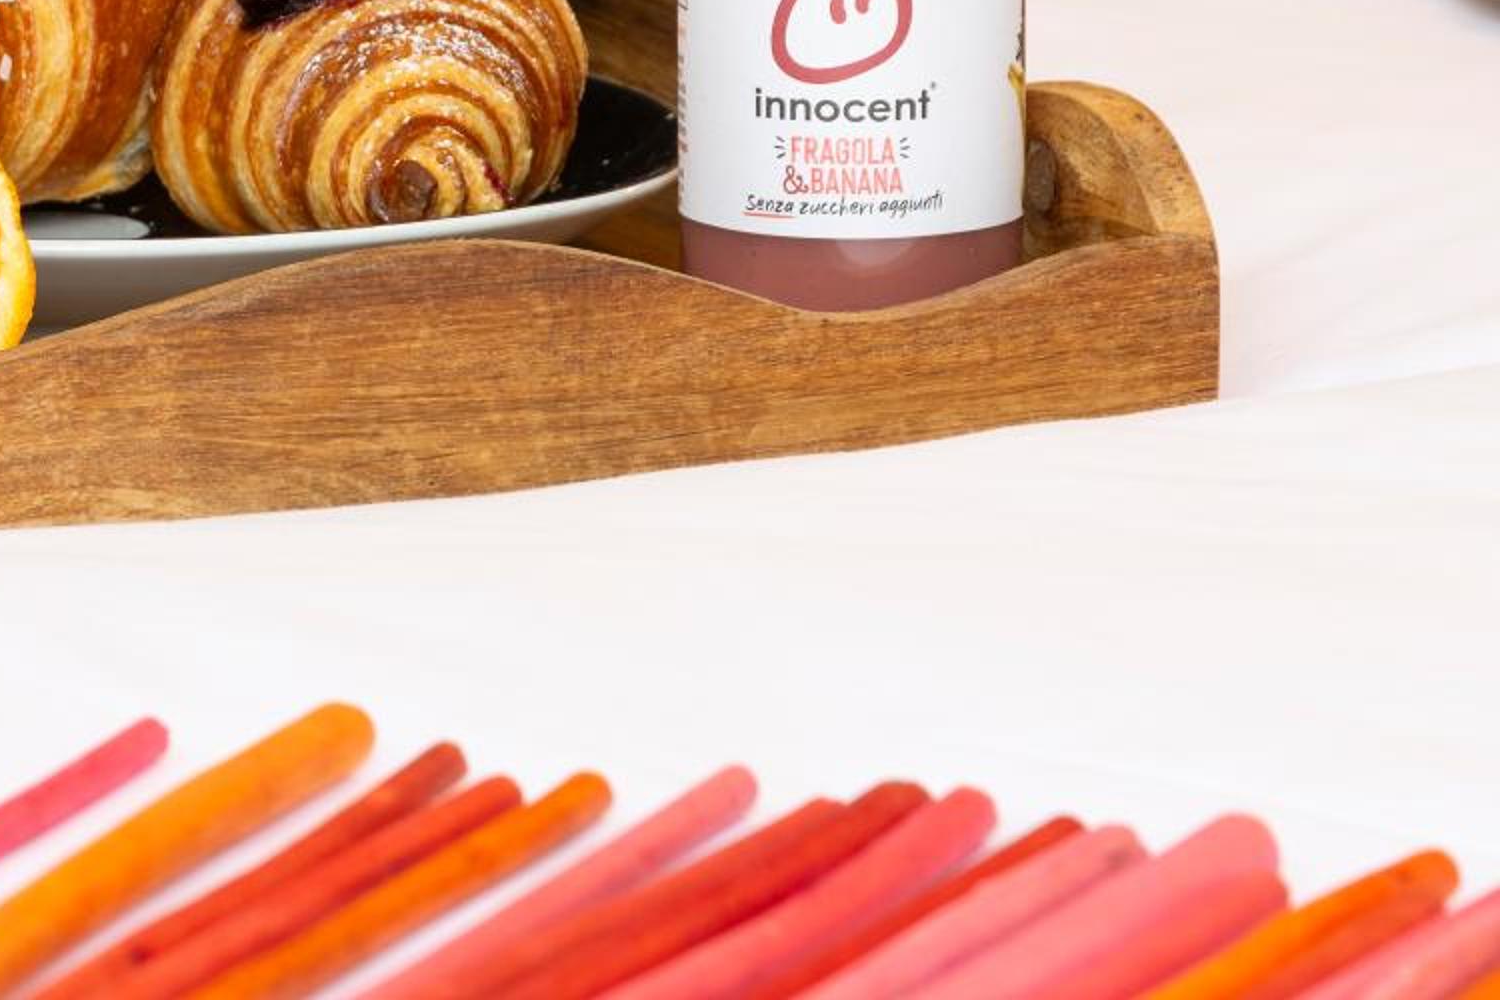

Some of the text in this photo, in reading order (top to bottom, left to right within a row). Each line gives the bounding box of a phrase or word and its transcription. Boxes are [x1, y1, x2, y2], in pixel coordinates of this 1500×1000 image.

[755, 87, 931, 122] innocent
[790, 136, 896, 165] FRAGOLA
[746, 189, 945, 218] Senza zuccheri aggiunti
